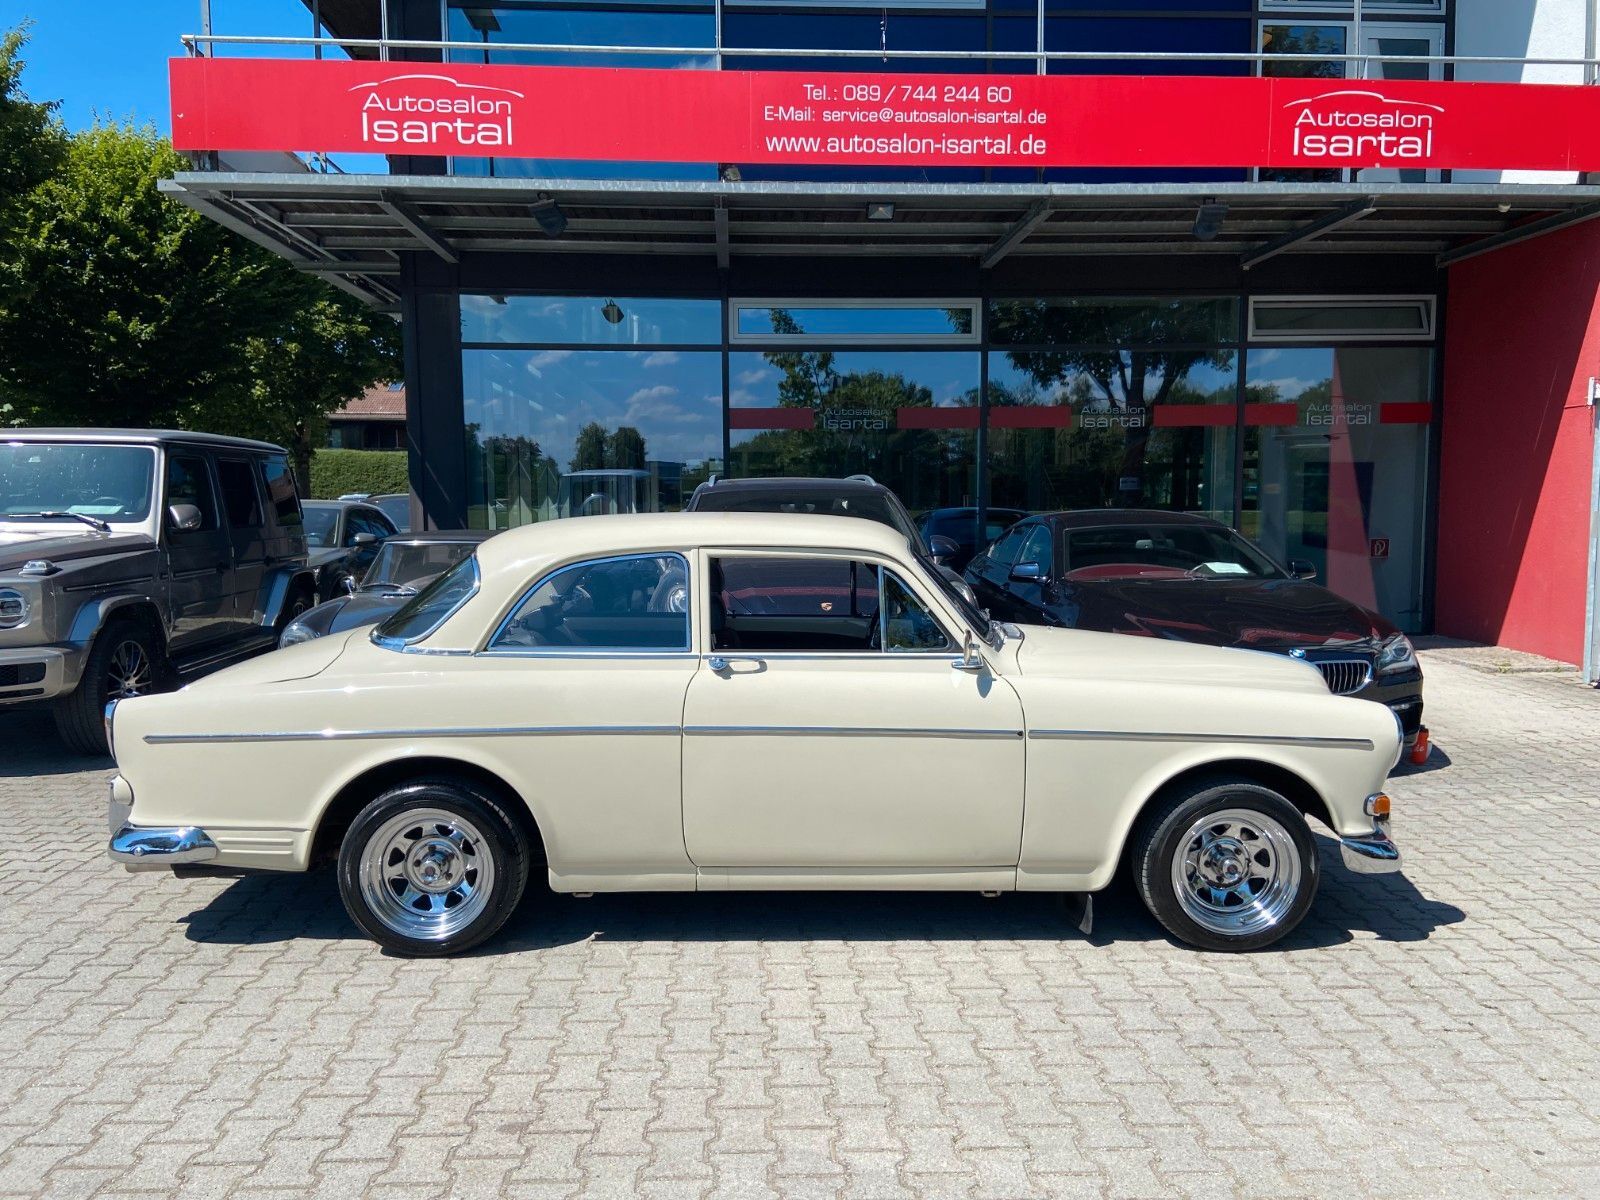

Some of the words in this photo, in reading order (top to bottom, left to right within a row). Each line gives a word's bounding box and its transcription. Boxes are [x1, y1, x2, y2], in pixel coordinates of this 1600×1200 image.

[803, 84, 837, 101] Tel.:
[843, 84, 880, 101] 089
[900, 85, 937, 102] 744
[944, 86, 980, 102] 244
[987, 86, 1011, 103] 60
[362, 92, 511, 115] Autosalon
[764, 105, 815, 121] E-Mail:
[822, 107, 1046, 124] service@autosalon-isartal.de
[1295, 108, 1432, 128] Autosalon
[362, 112, 513, 146] Isartal
[766, 132, 1046, 155] www.autosalon-isartal.de
[1293, 127, 1432, 158] Isartal
[1081, 406, 1145, 414] Autosalon
[1306, 411, 1371, 425] Isartal
[823, 415, 888, 430] Isartal
[1080, 414, 1145, 428] Isartal
